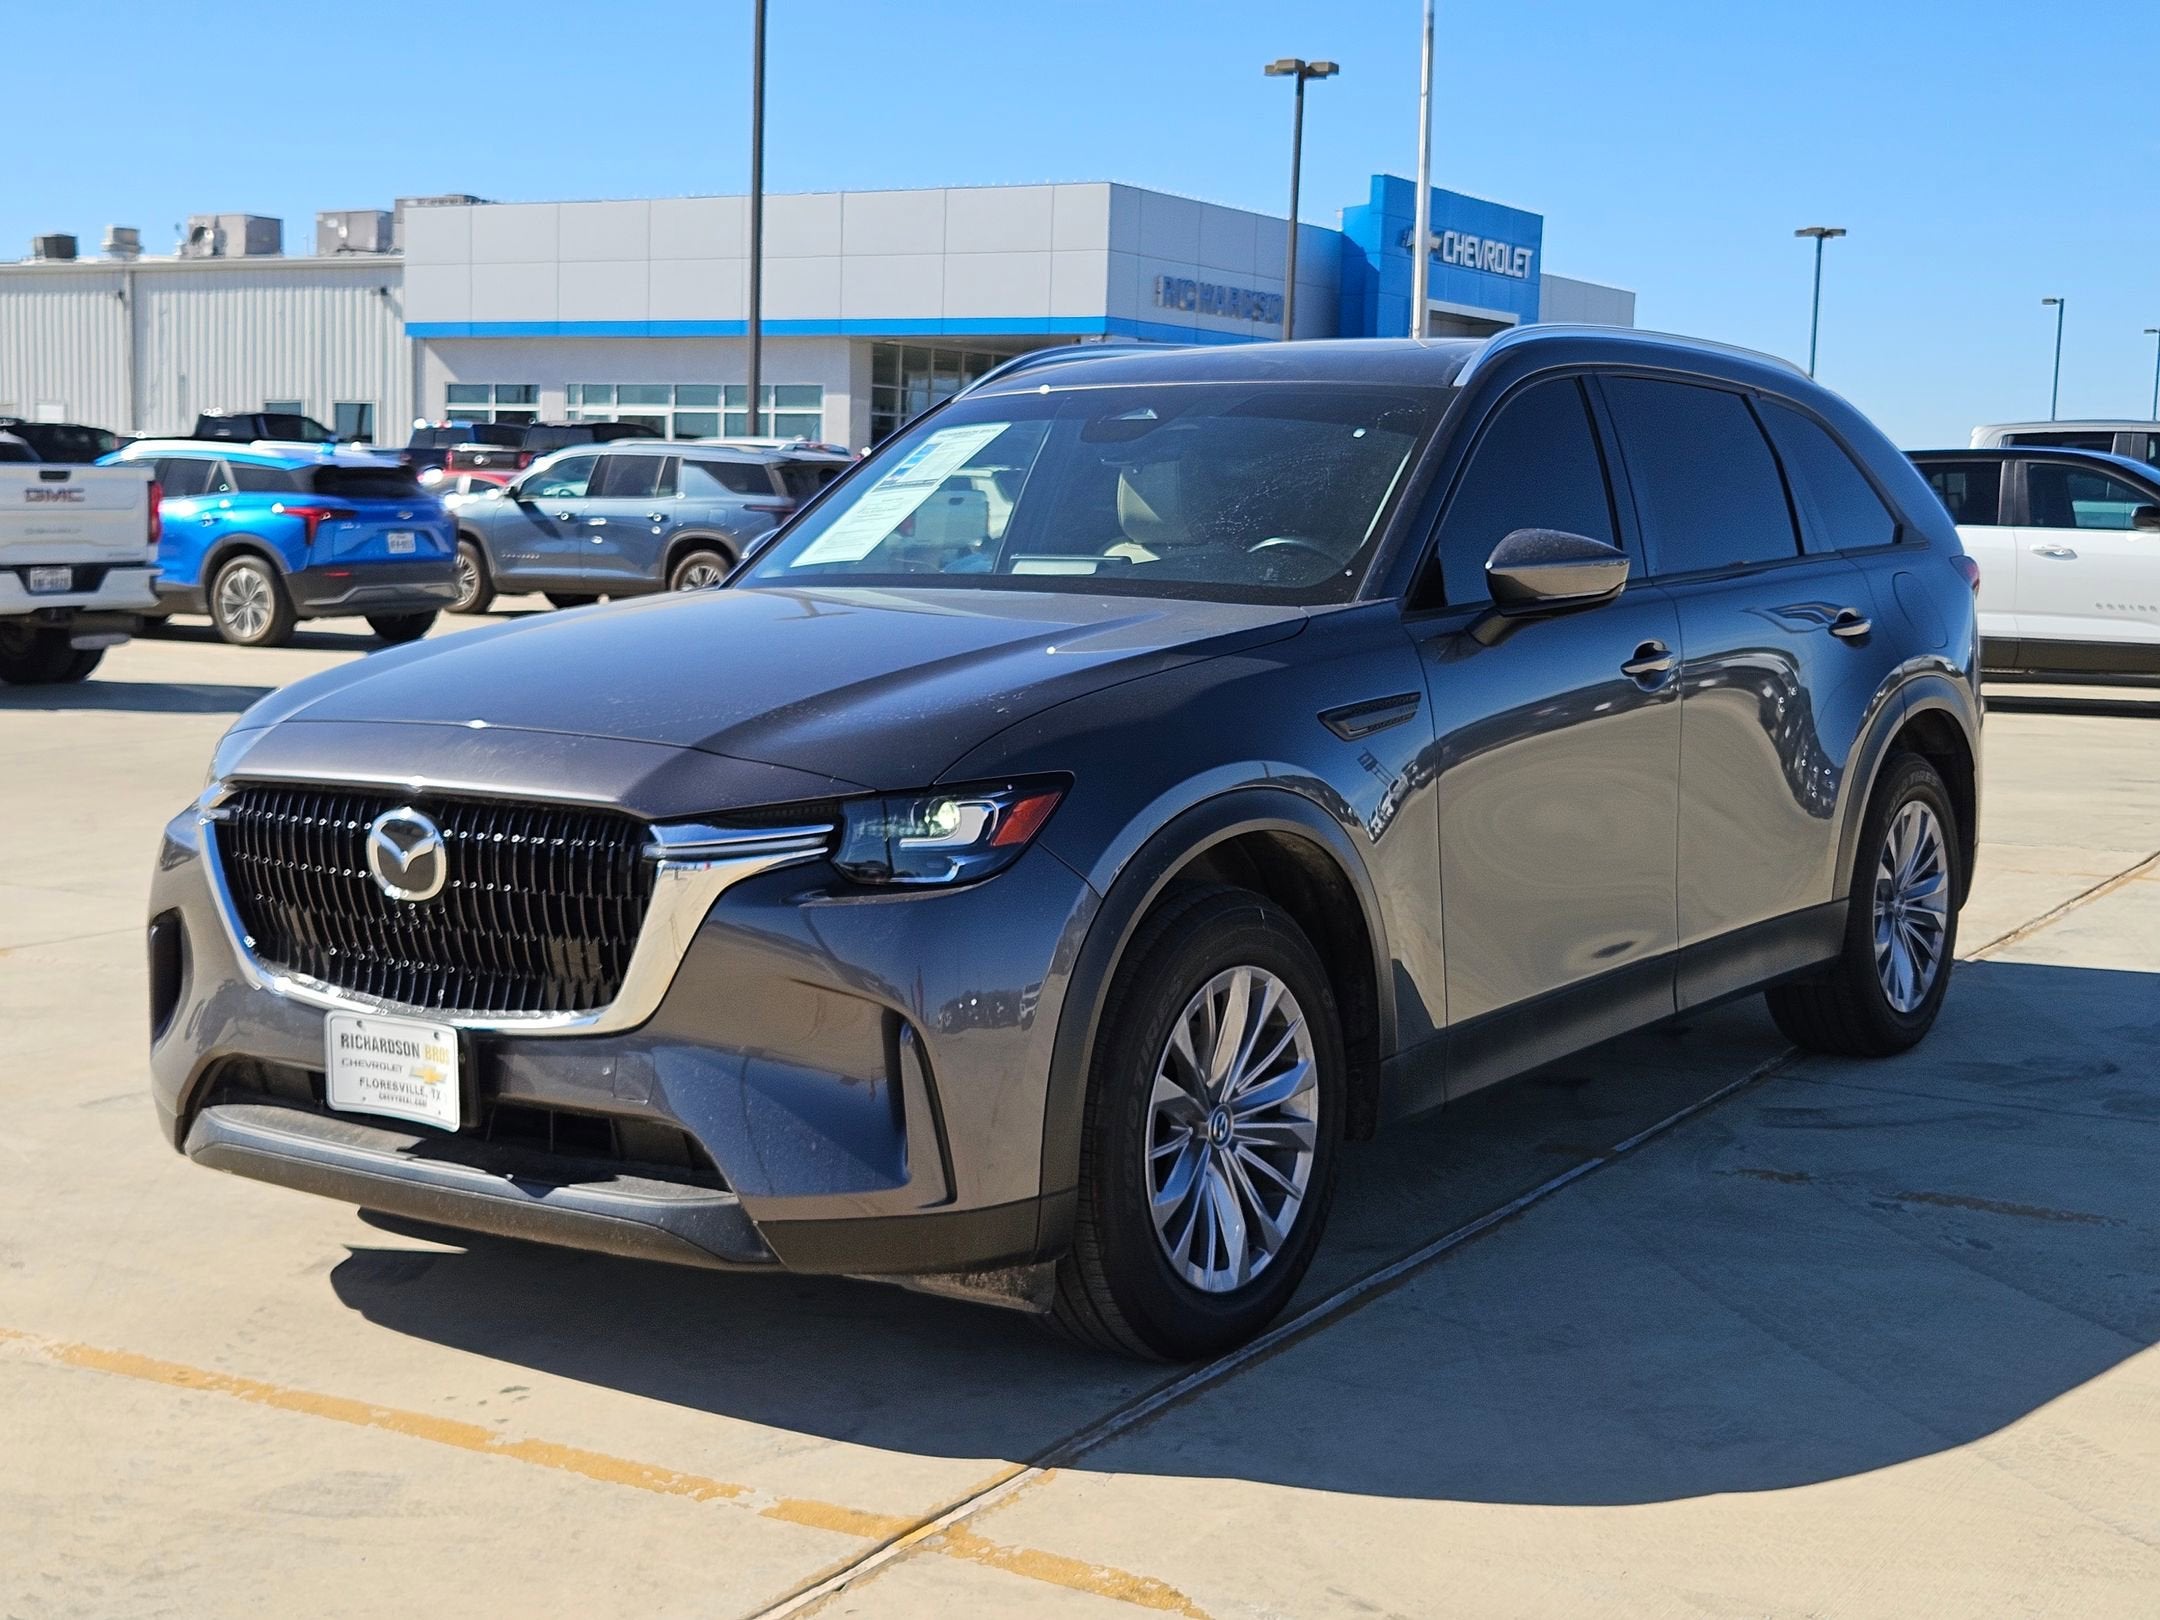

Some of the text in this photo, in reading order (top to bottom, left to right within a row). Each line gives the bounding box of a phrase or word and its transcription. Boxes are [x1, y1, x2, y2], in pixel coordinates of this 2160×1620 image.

[1443, 230, 1533, 279] CHEVROLET
[25, 487, 85, 503] GMC
[340, 1032, 421, 1059] RICHARDSON
[341, 1058, 404, 1074] CHEVROLET
[431, 1087, 442, 1101] TX
